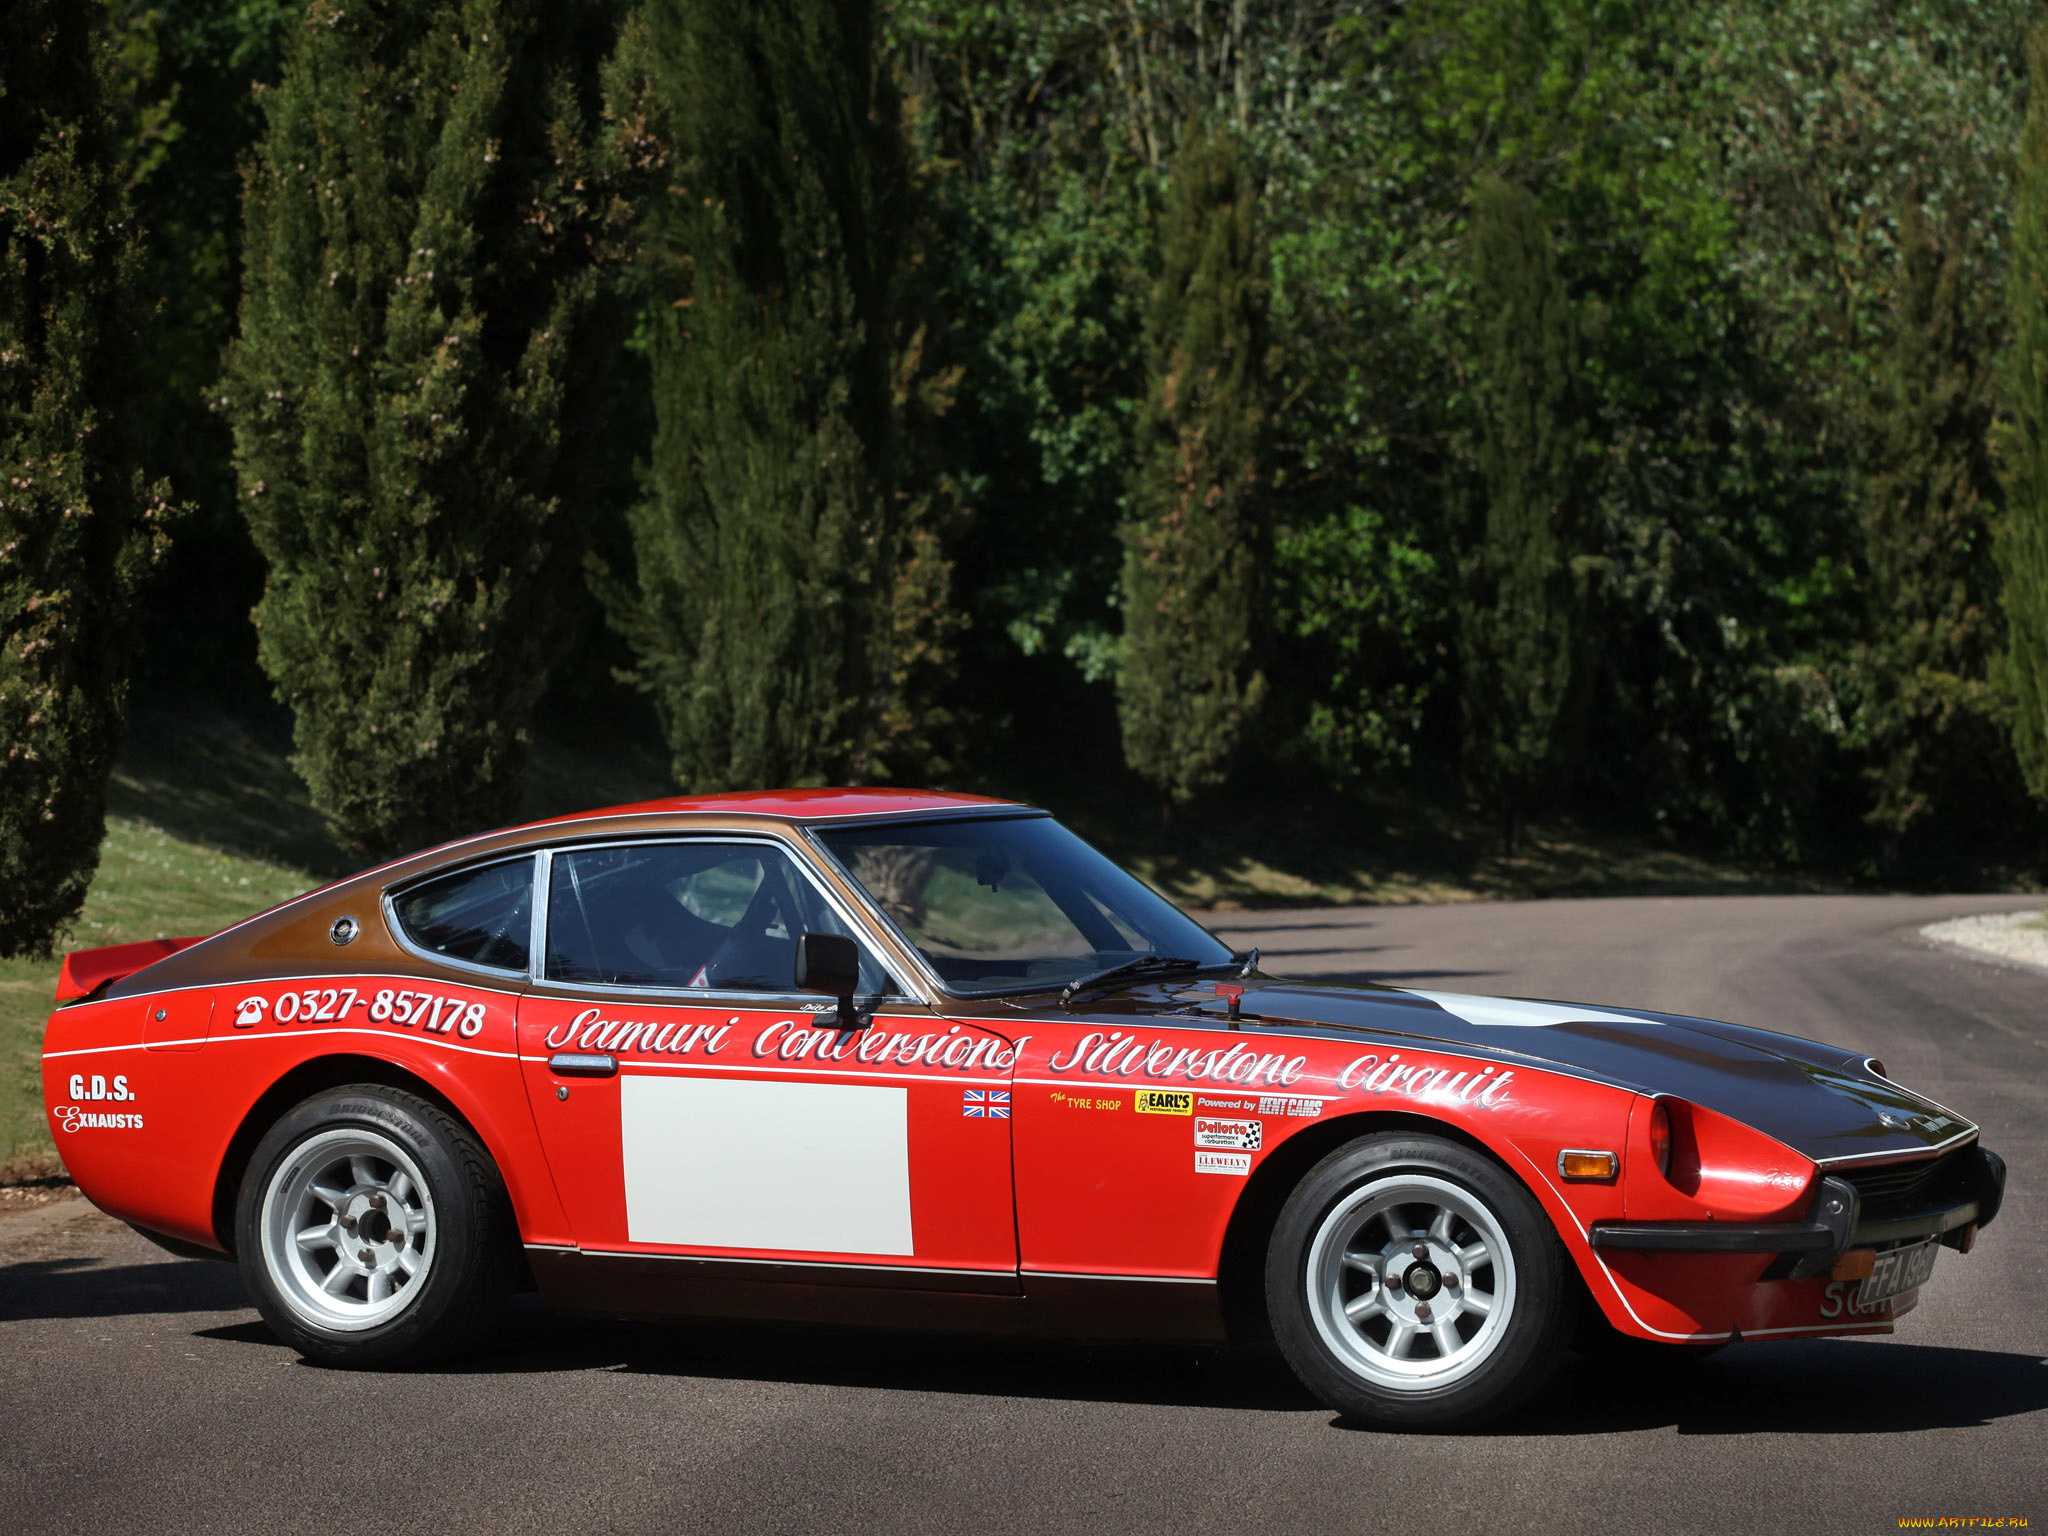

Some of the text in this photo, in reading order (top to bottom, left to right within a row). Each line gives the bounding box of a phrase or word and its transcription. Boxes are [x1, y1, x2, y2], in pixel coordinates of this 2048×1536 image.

[544, 1008, 739, 1054] Samuri
[1049, 1032, 1306, 1088] Silverstone
[1337, 1054, 1515, 1110] Circuit
[69, 1074, 135, 1101] G.D.S.
[1050, 1092, 1122, 1111] The TYRE SHOP
[1149, 1093, 1190, 1109] EARL'S
[1197, 1097, 1323, 1117] Powered by KENT CAMS
[1198, 1121, 1247, 1135] Dellorto
[1199, 1156, 1249, 1167] LLEWELYN
[1863, 1254, 1904, 1299] FFA
